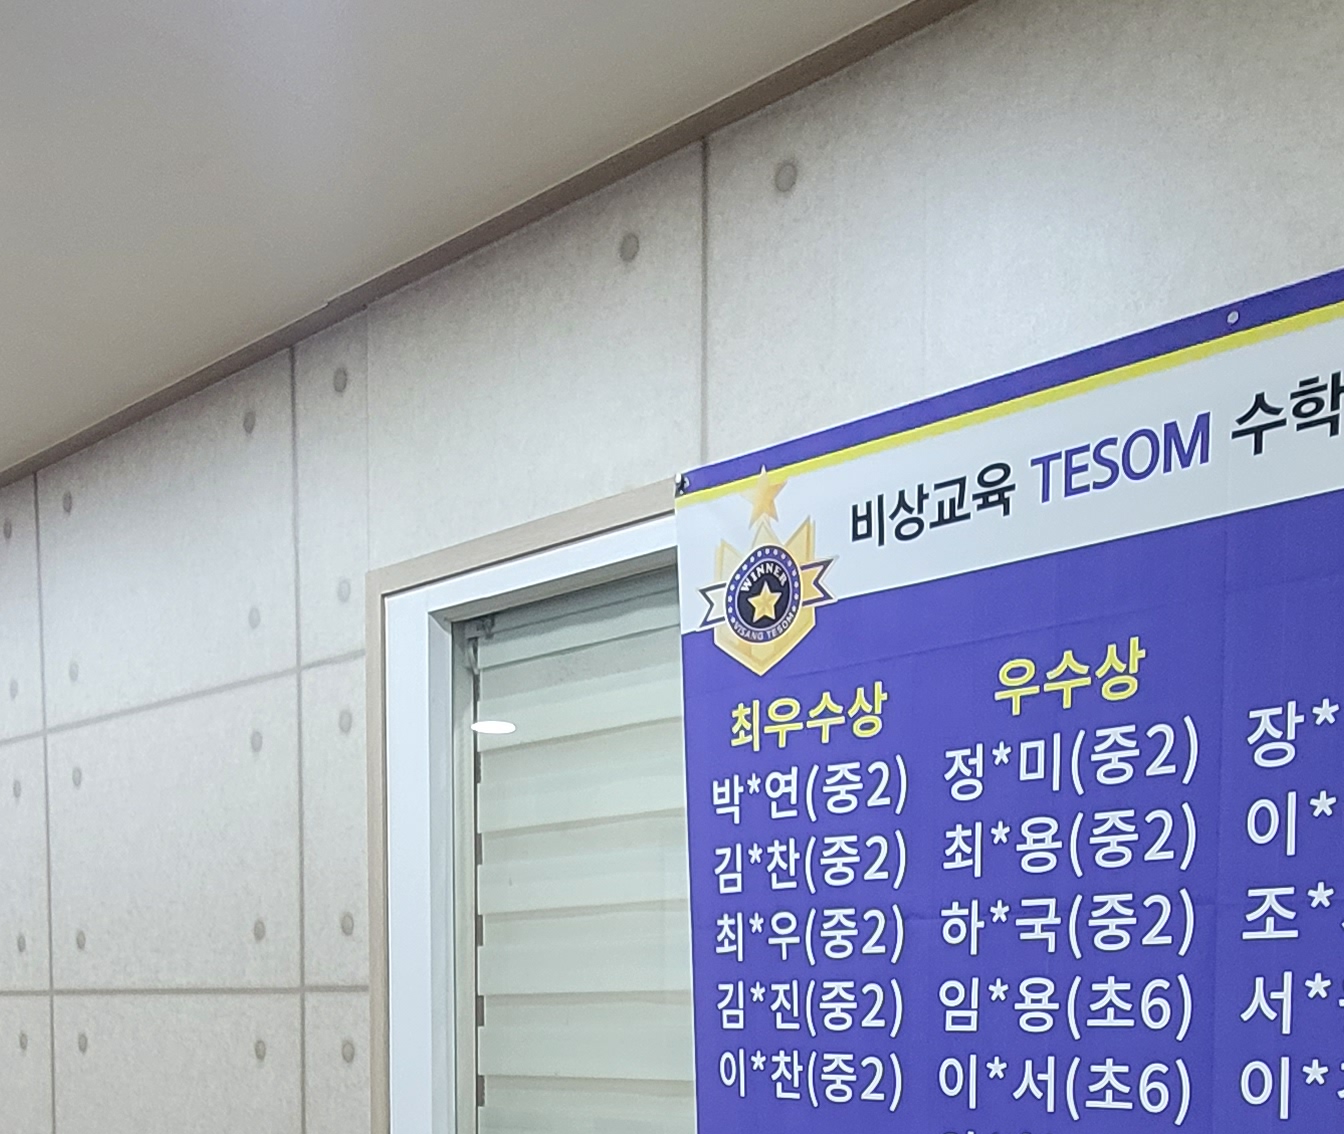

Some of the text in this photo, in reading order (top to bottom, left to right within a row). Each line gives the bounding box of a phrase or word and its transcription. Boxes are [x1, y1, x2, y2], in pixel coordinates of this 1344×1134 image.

[851, 462, 1016, 547] 비상교육
[1031, 412, 1211, 503] TESOM
[741, 562, 788, 593] WINNER
[733, 611, 795, 642] VISANG TESOM
[994, 637, 1146, 715] 우수상
[730, 681, 888, 751] 최우수상
